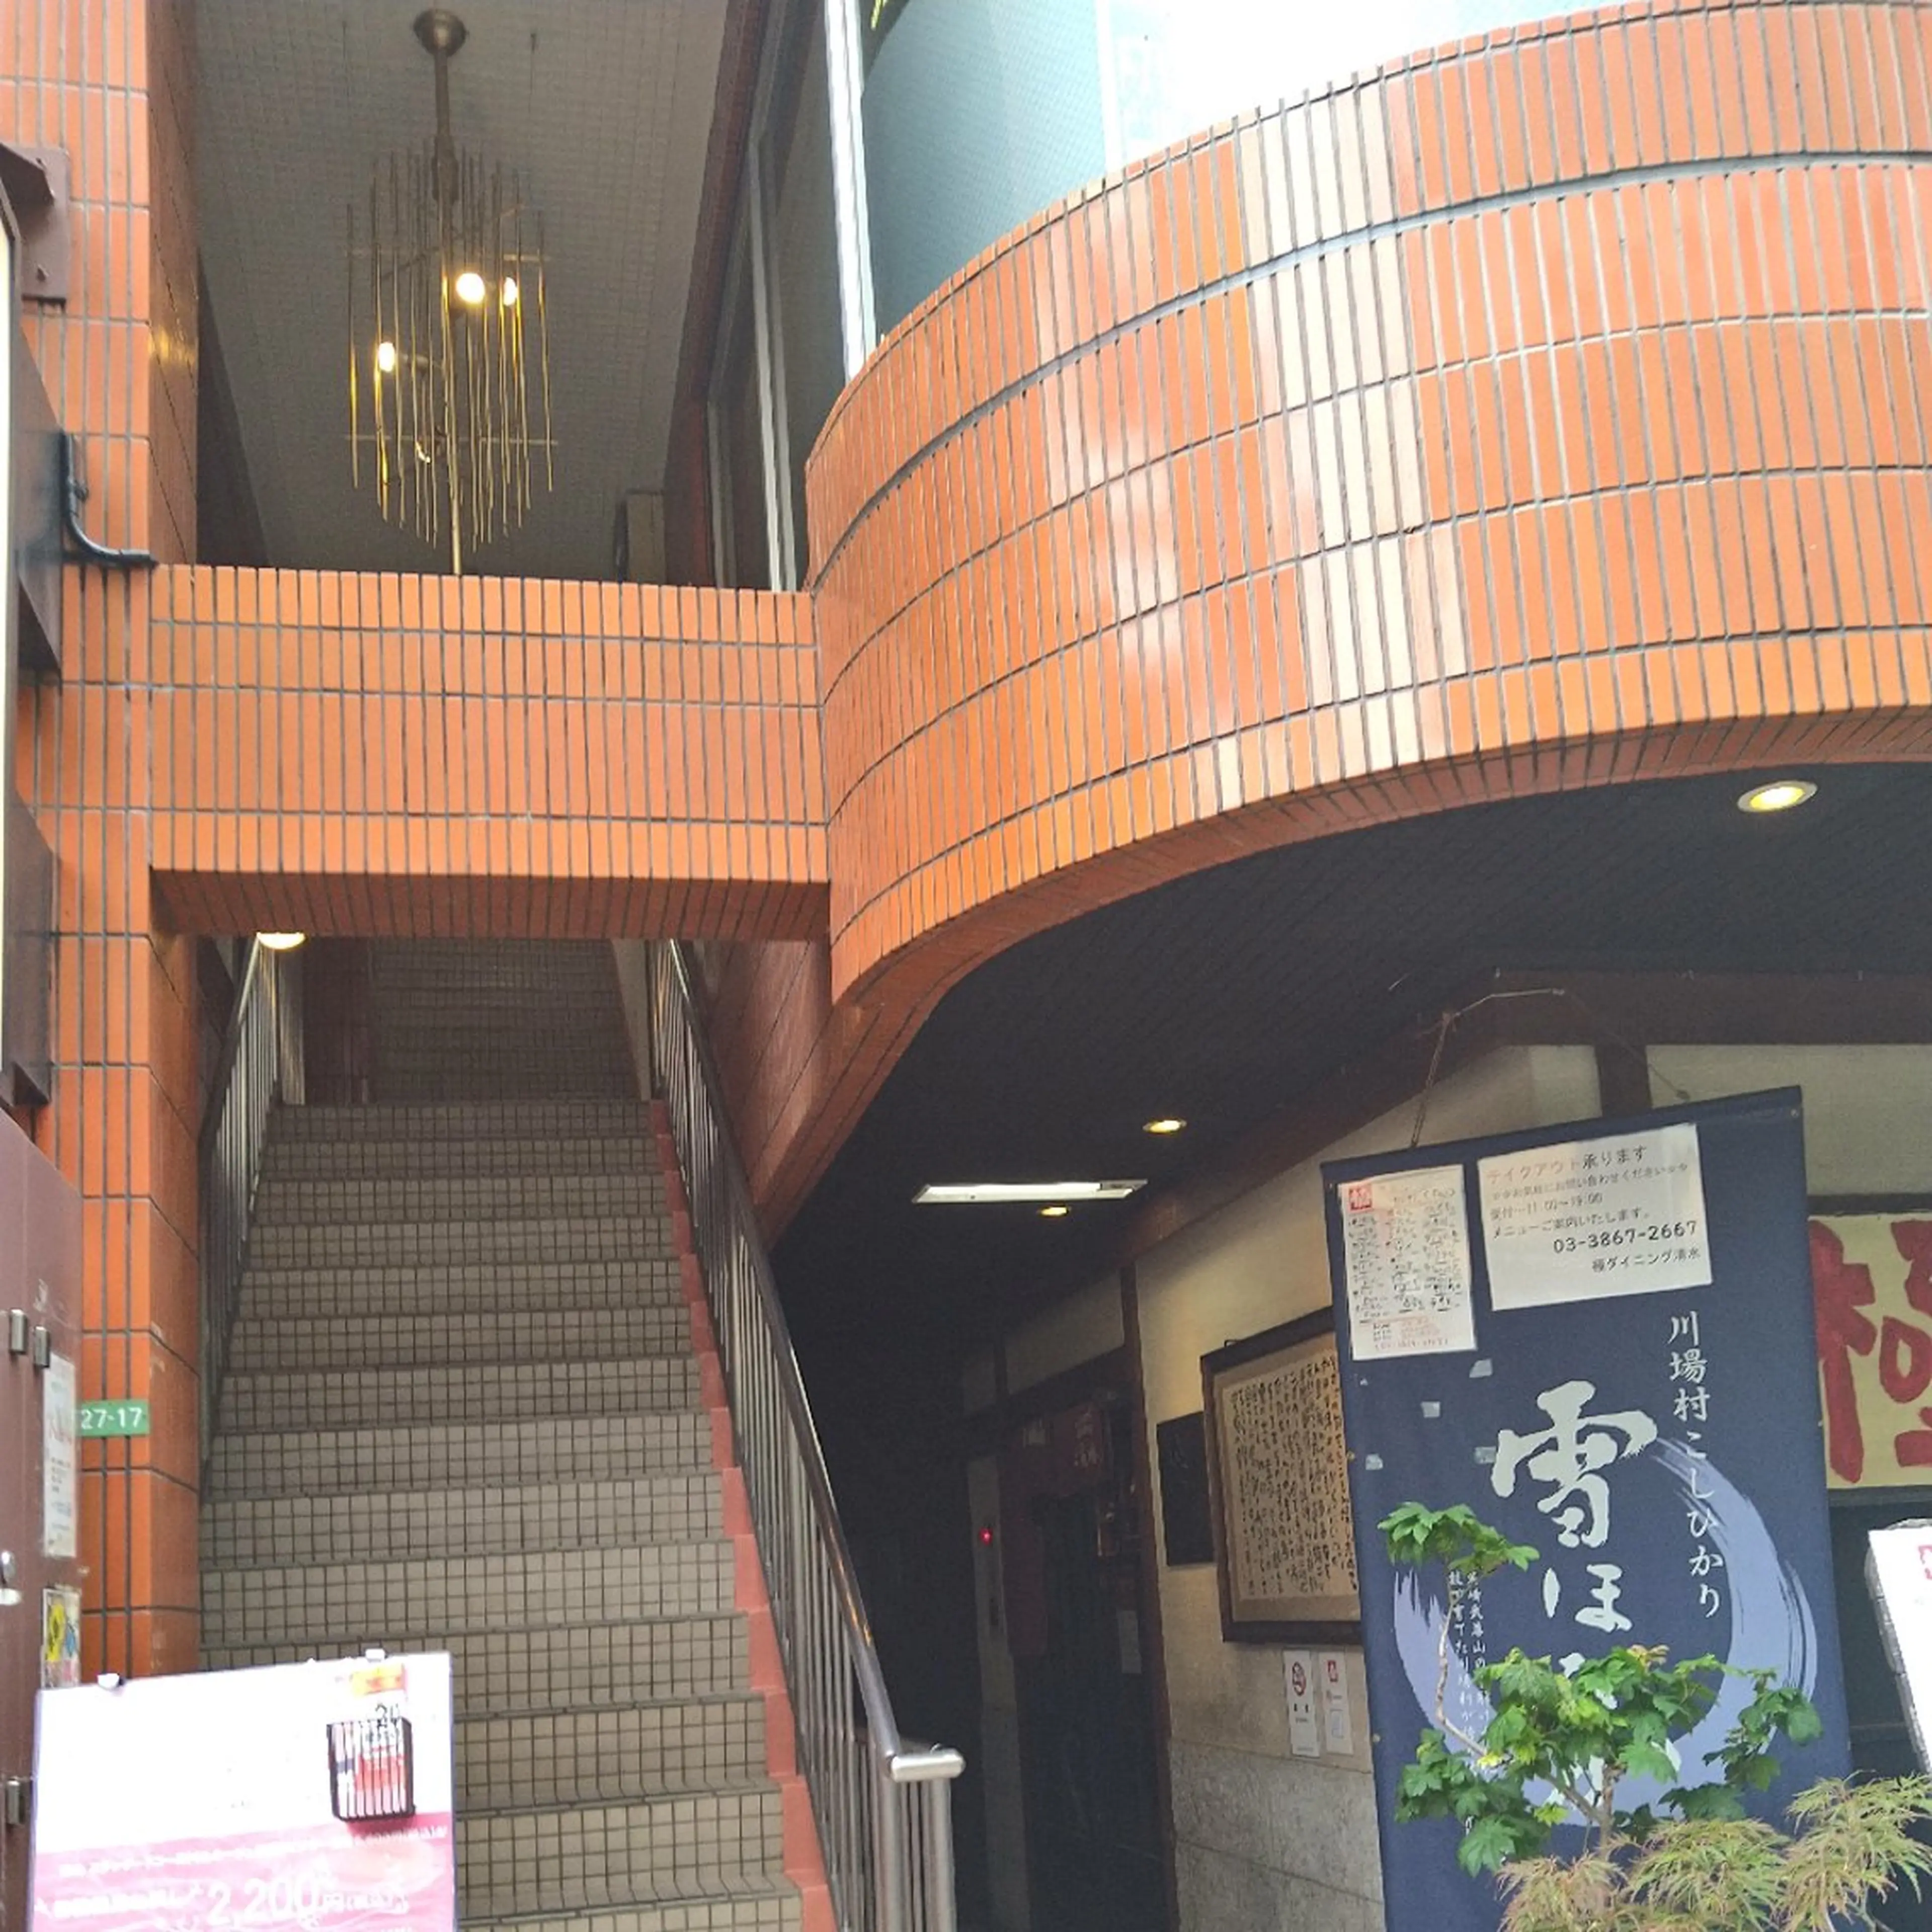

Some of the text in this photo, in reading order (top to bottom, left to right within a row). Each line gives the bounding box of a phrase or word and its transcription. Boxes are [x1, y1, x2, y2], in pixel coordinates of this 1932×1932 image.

[1486, 1145, 1647, 1184] テイクアウト承ります
[81, 1407, 142, 1429] 27-17
[1667, 1311, 1724, 1618] 川場村こしひかり
